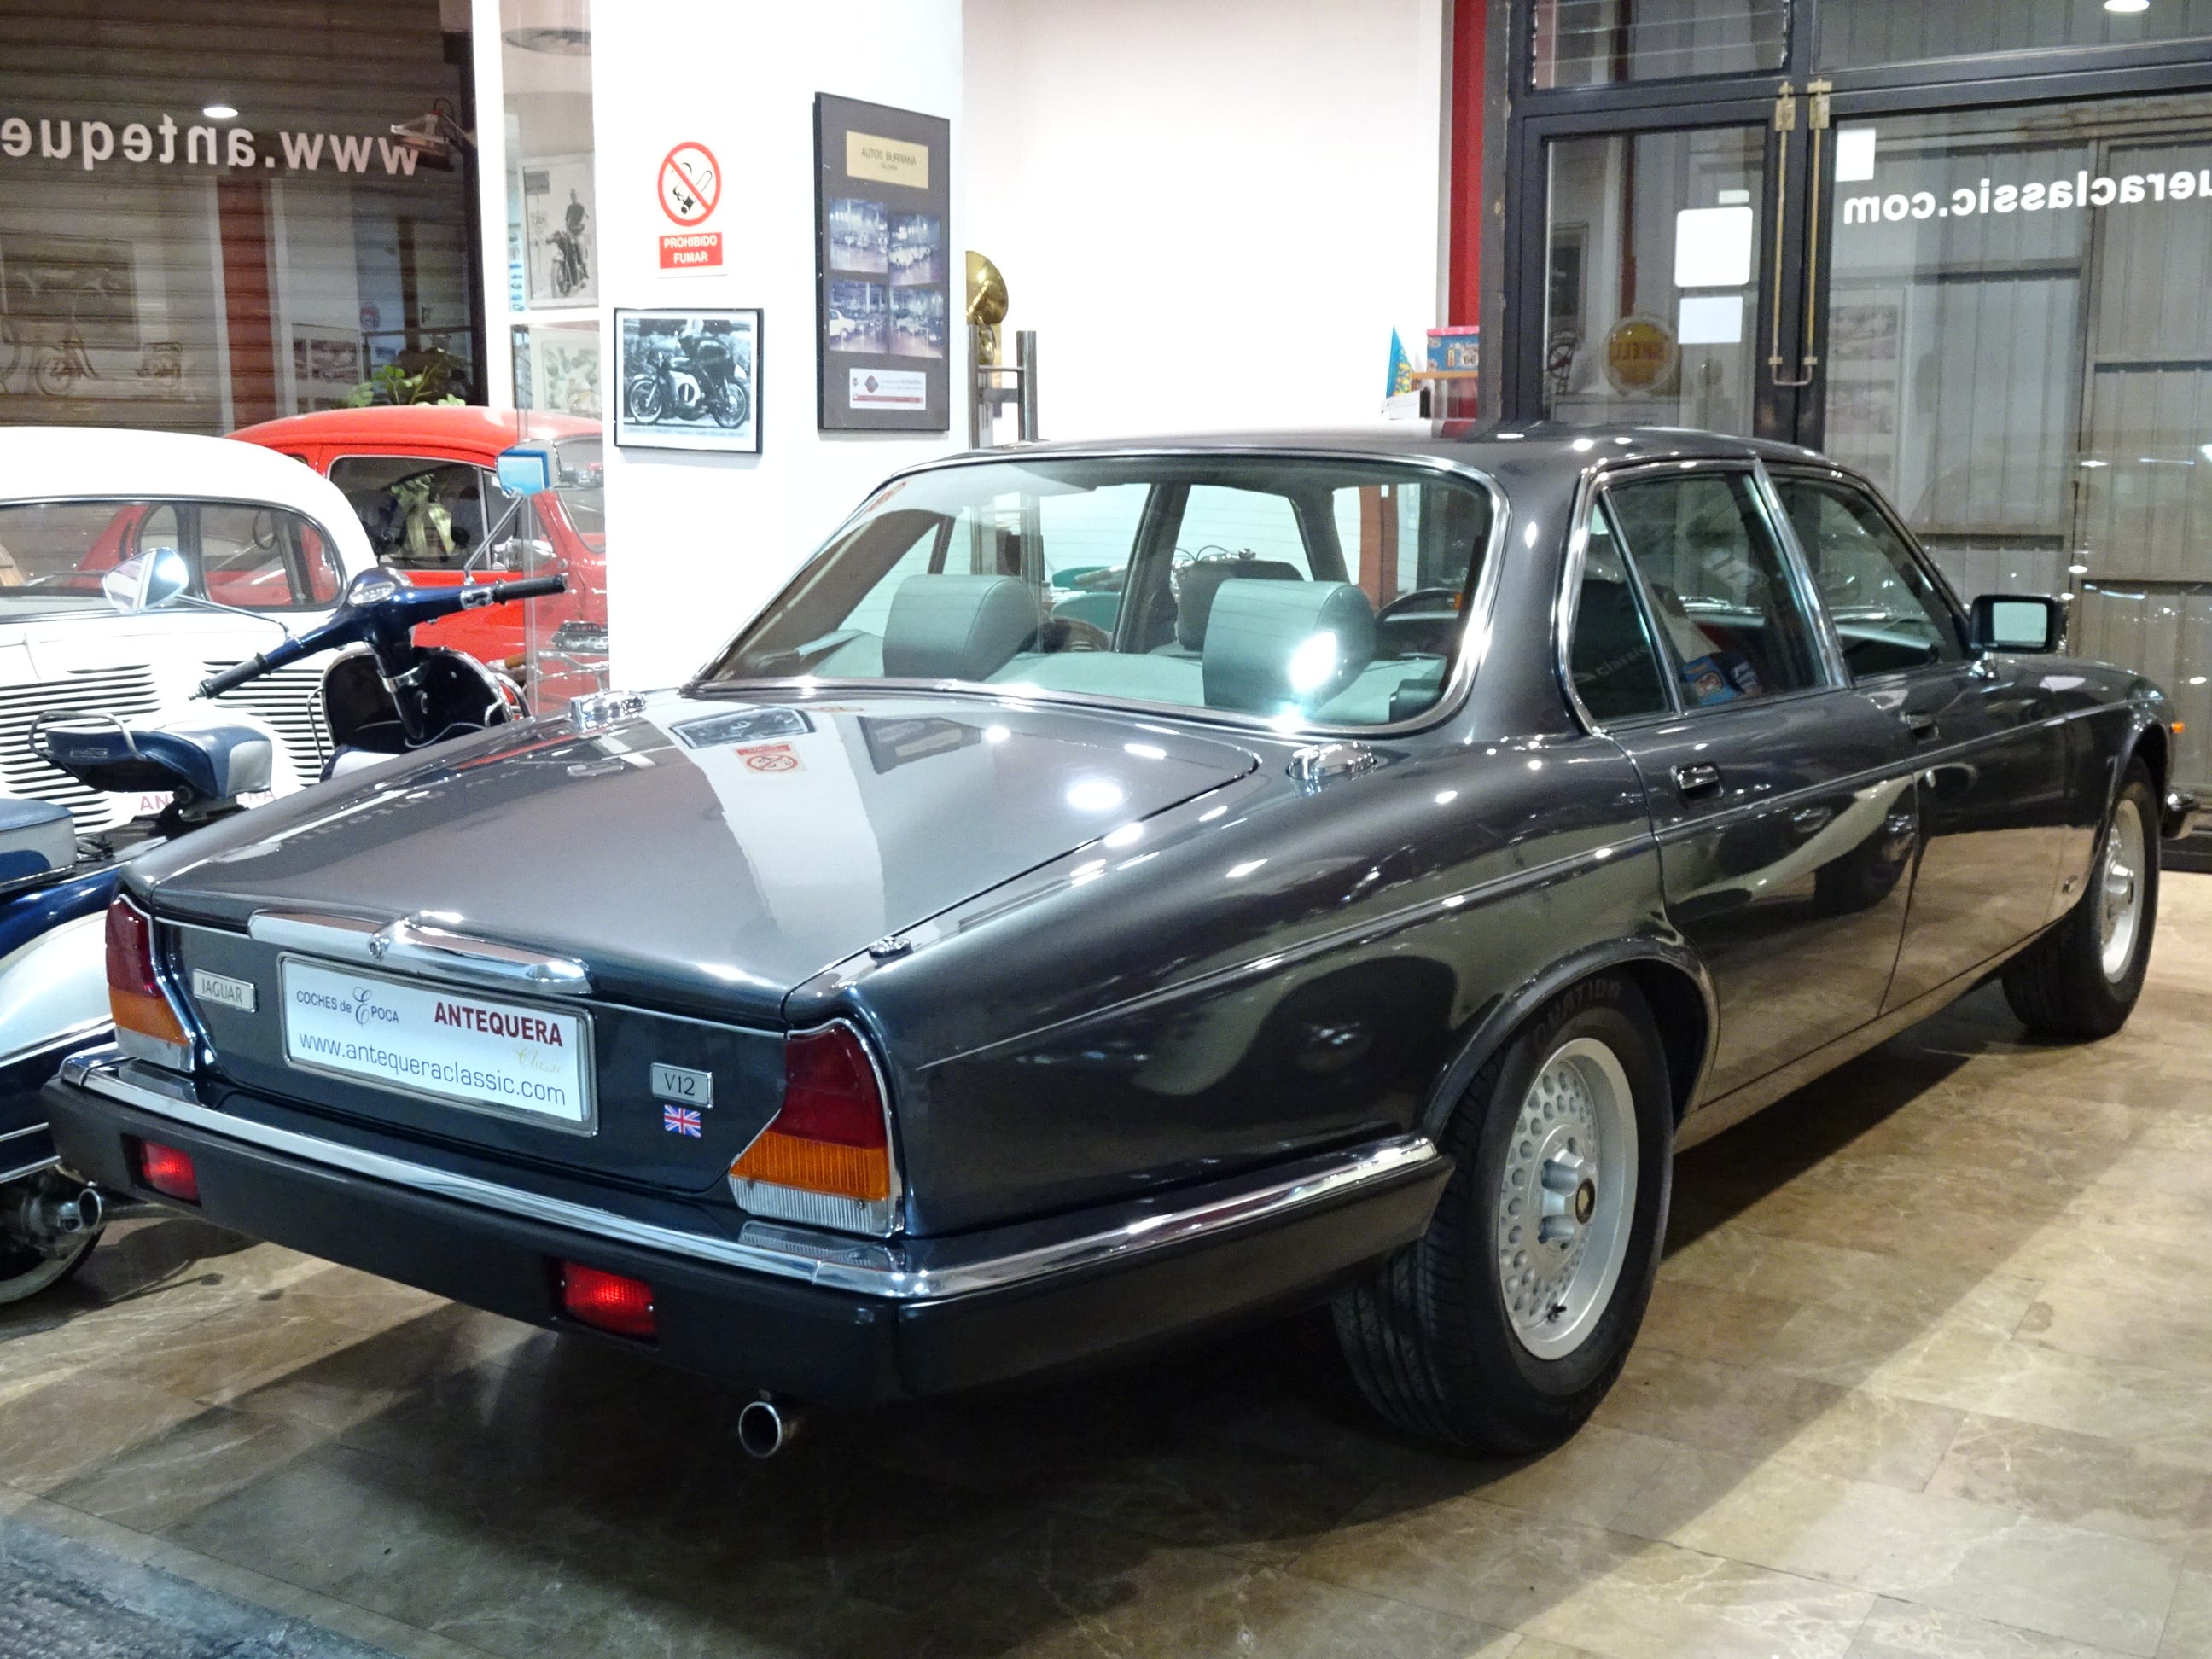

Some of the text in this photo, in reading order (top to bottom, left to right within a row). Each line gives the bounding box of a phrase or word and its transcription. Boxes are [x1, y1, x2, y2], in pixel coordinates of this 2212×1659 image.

[861, 148, 884, 160] AUTOS
[664, 234, 718, 249] PROHIBIDO
[673, 251, 708, 264] FUMAR
[201, 977, 242, 1004] JAGUAR
[296, 990, 337, 1010] COCHES
[340, 1000, 352, 1013] de
[434, 1001, 563, 1047] ANTEQUERA
[299, 1032, 567, 1106] www.antequeraclassic.com
[664, 1073, 695, 1097] V12
